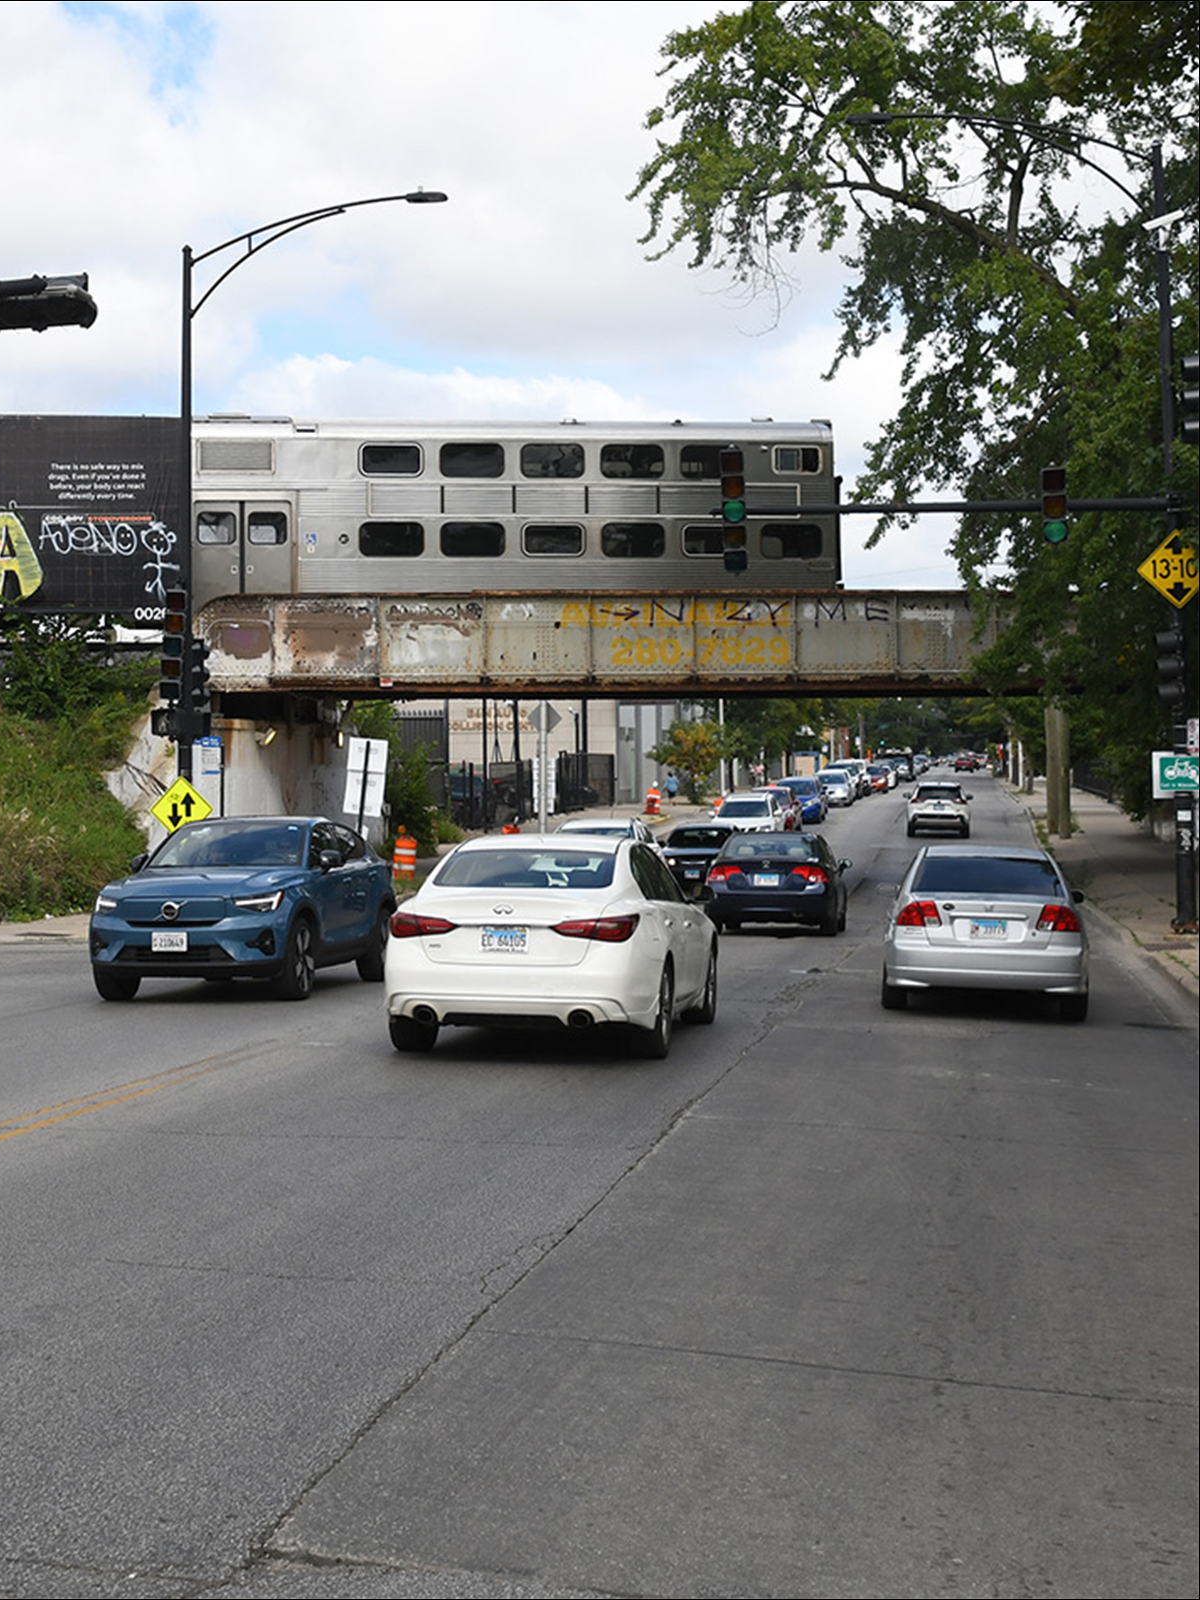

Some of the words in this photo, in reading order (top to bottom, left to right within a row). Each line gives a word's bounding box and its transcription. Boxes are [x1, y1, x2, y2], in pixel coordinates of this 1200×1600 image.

[91, 462, 104, 470] safe
[106, 464, 120, 472] way
[48, 473, 70, 481] drugs.
[91, 472, 97, 480] if
[97, 472, 120, 481] you've
[122, 472, 139, 480] done
[49, 482, 75, 491] before,
[93, 482, 111, 491] body
[58, 492, 95, 500] differently
[610, 636, 790, 666] 280-7829
